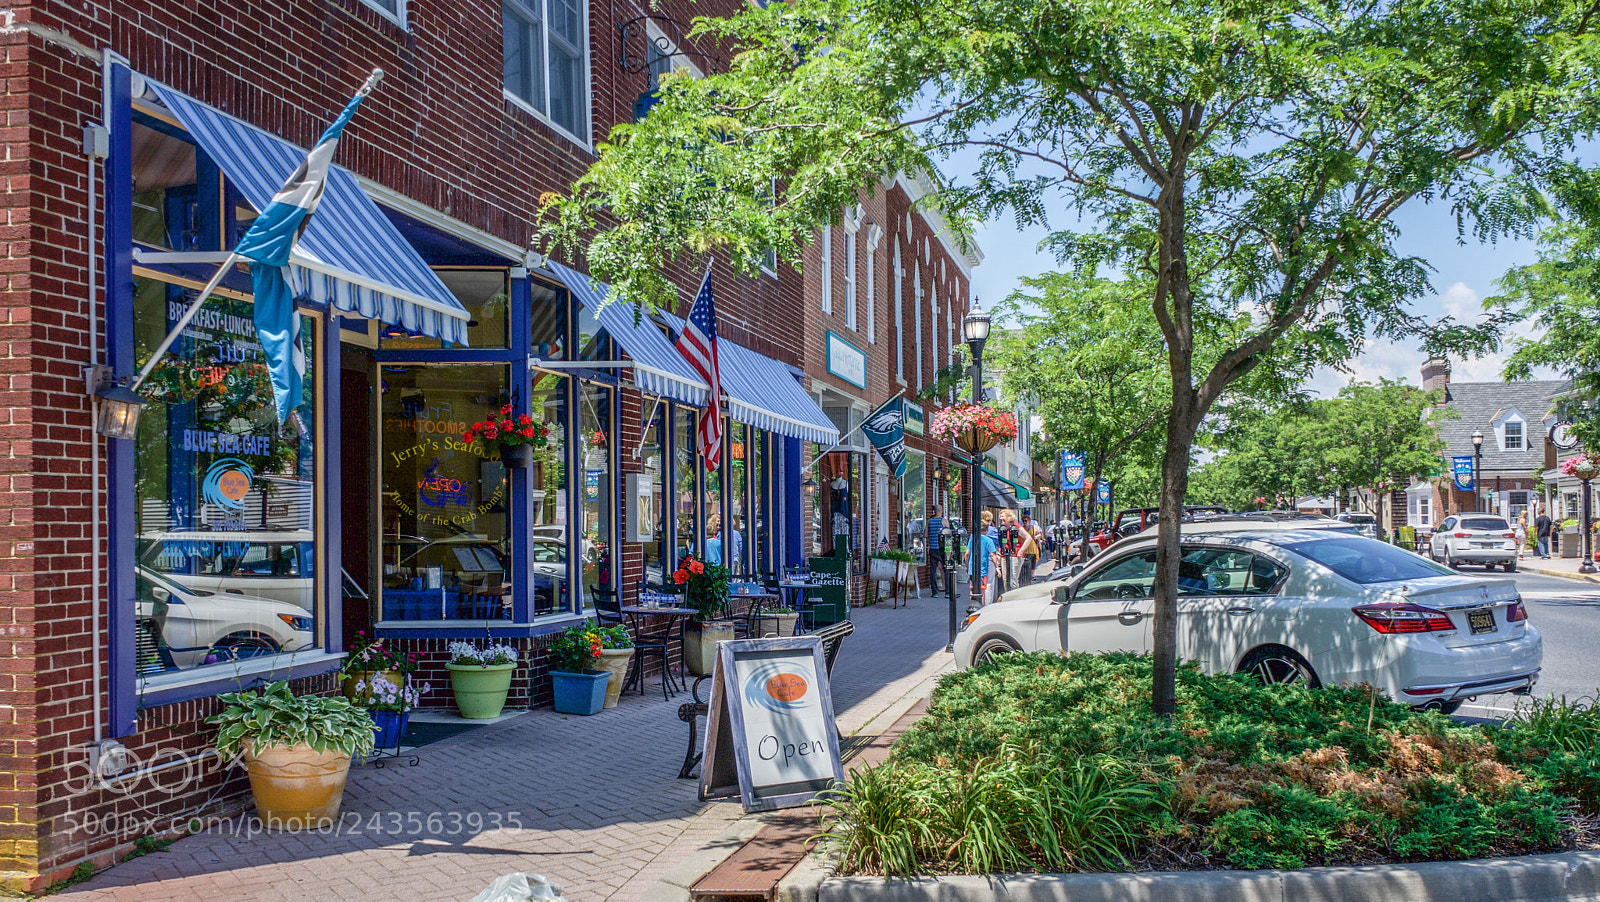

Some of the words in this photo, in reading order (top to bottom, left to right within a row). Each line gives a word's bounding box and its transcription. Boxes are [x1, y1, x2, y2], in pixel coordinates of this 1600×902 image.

[224, 314, 254, 338] LUNCH
[184, 429, 215, 452] BLUE
[217, 432, 241, 455] SEA
[242, 435, 270, 456] CAFE
[391, 438, 439, 468] Jerry's
[222, 477, 235, 486] Blue
[235, 478, 246, 487] Sea
[226, 486, 239, 495] Cafe
[417, 513, 430, 523] of
[432, 515, 449, 526] the
[452, 511, 477, 525] Crab
[810, 571, 832, 579] Cape
[811, 578, 845, 586] Gazette
[771, 679, 788, 689] Blue
[789, 678, 806, 687] Sea
[777, 688, 796, 700] Cafe
[758, 734, 825, 768] Open
